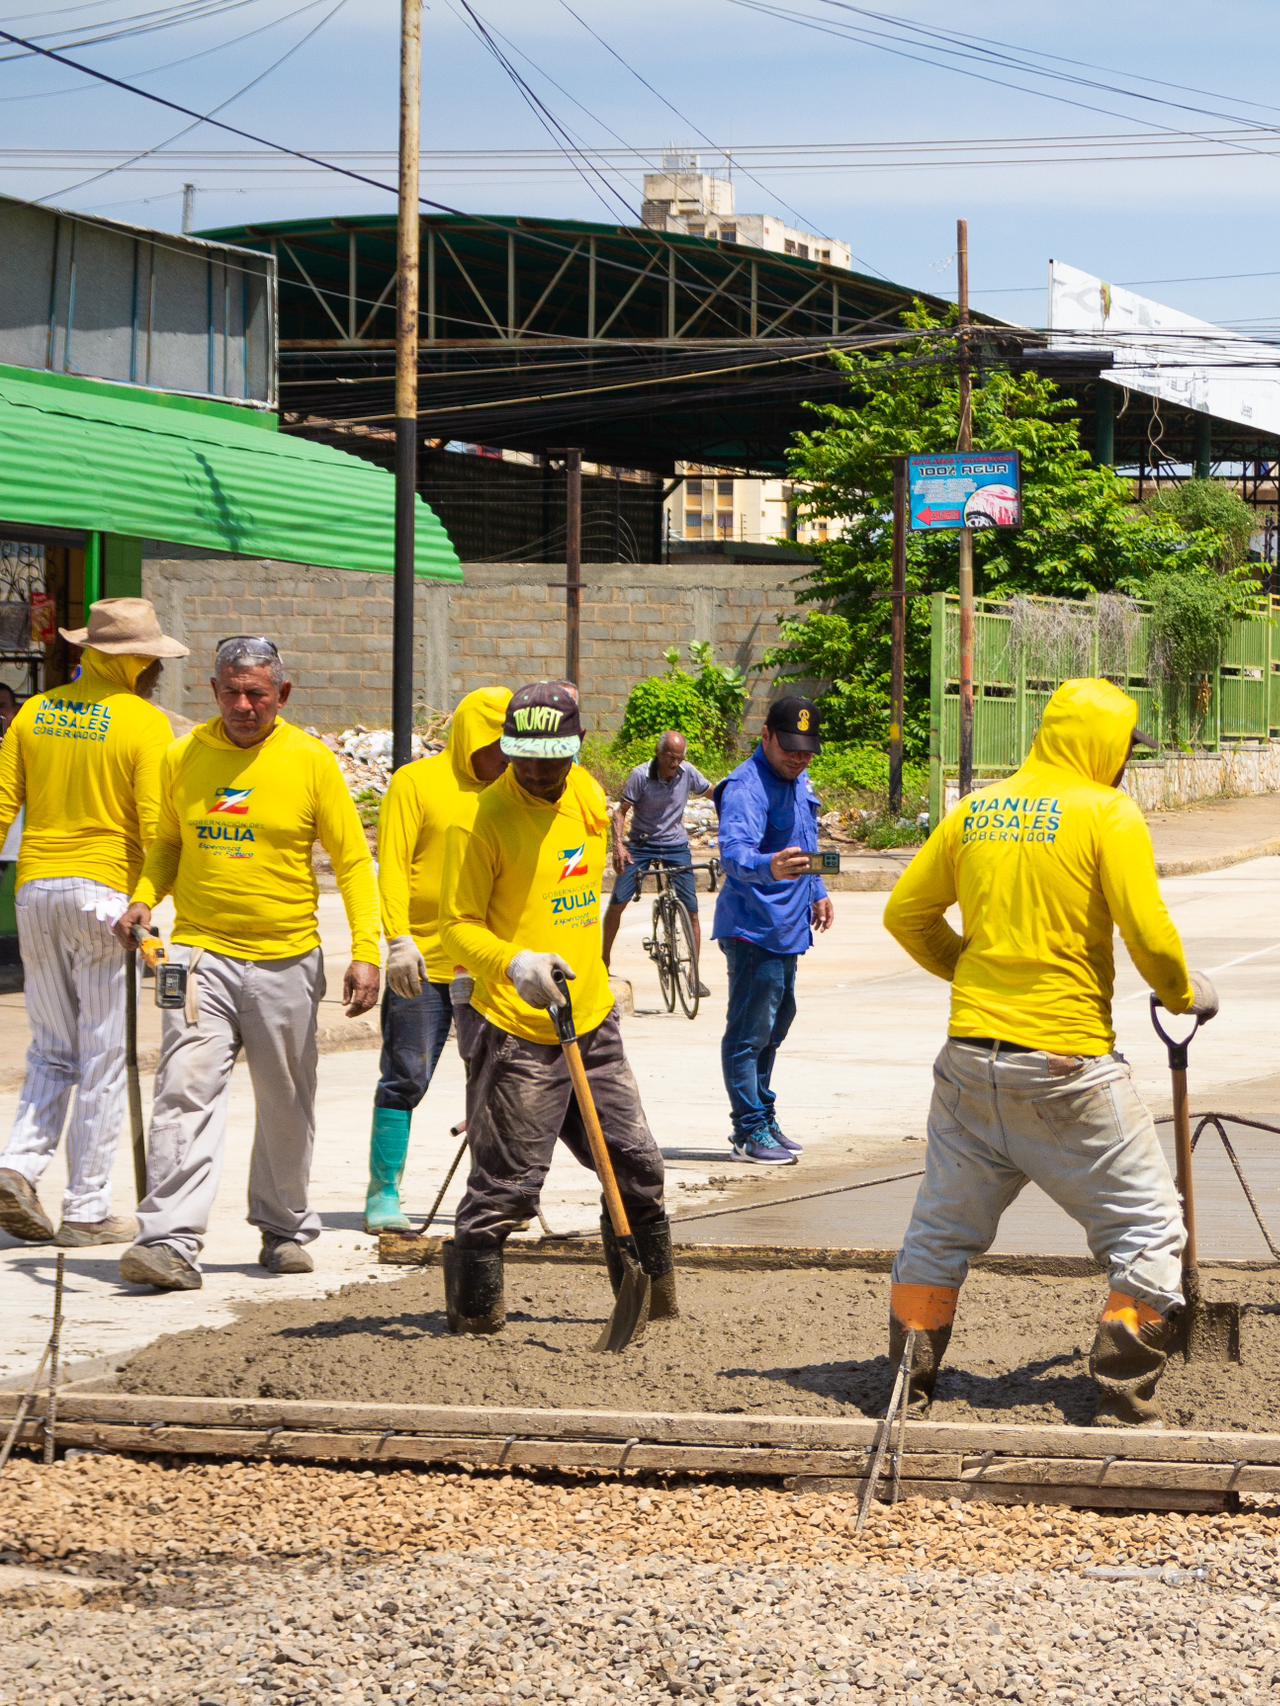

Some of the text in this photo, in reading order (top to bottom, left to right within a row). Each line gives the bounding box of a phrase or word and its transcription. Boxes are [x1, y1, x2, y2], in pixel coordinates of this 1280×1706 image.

[919, 463, 1008, 477] 100% AGUA
[39, 698, 112, 720] MANUEL
[513, 705, 564, 733] TRUKFIT
[970, 797, 1063, 815] MANUEL
[195, 825, 255, 842] ZULIA
[961, 830, 1056, 845] GOBERNDOR
[551, 890, 596, 914] ZULIA
